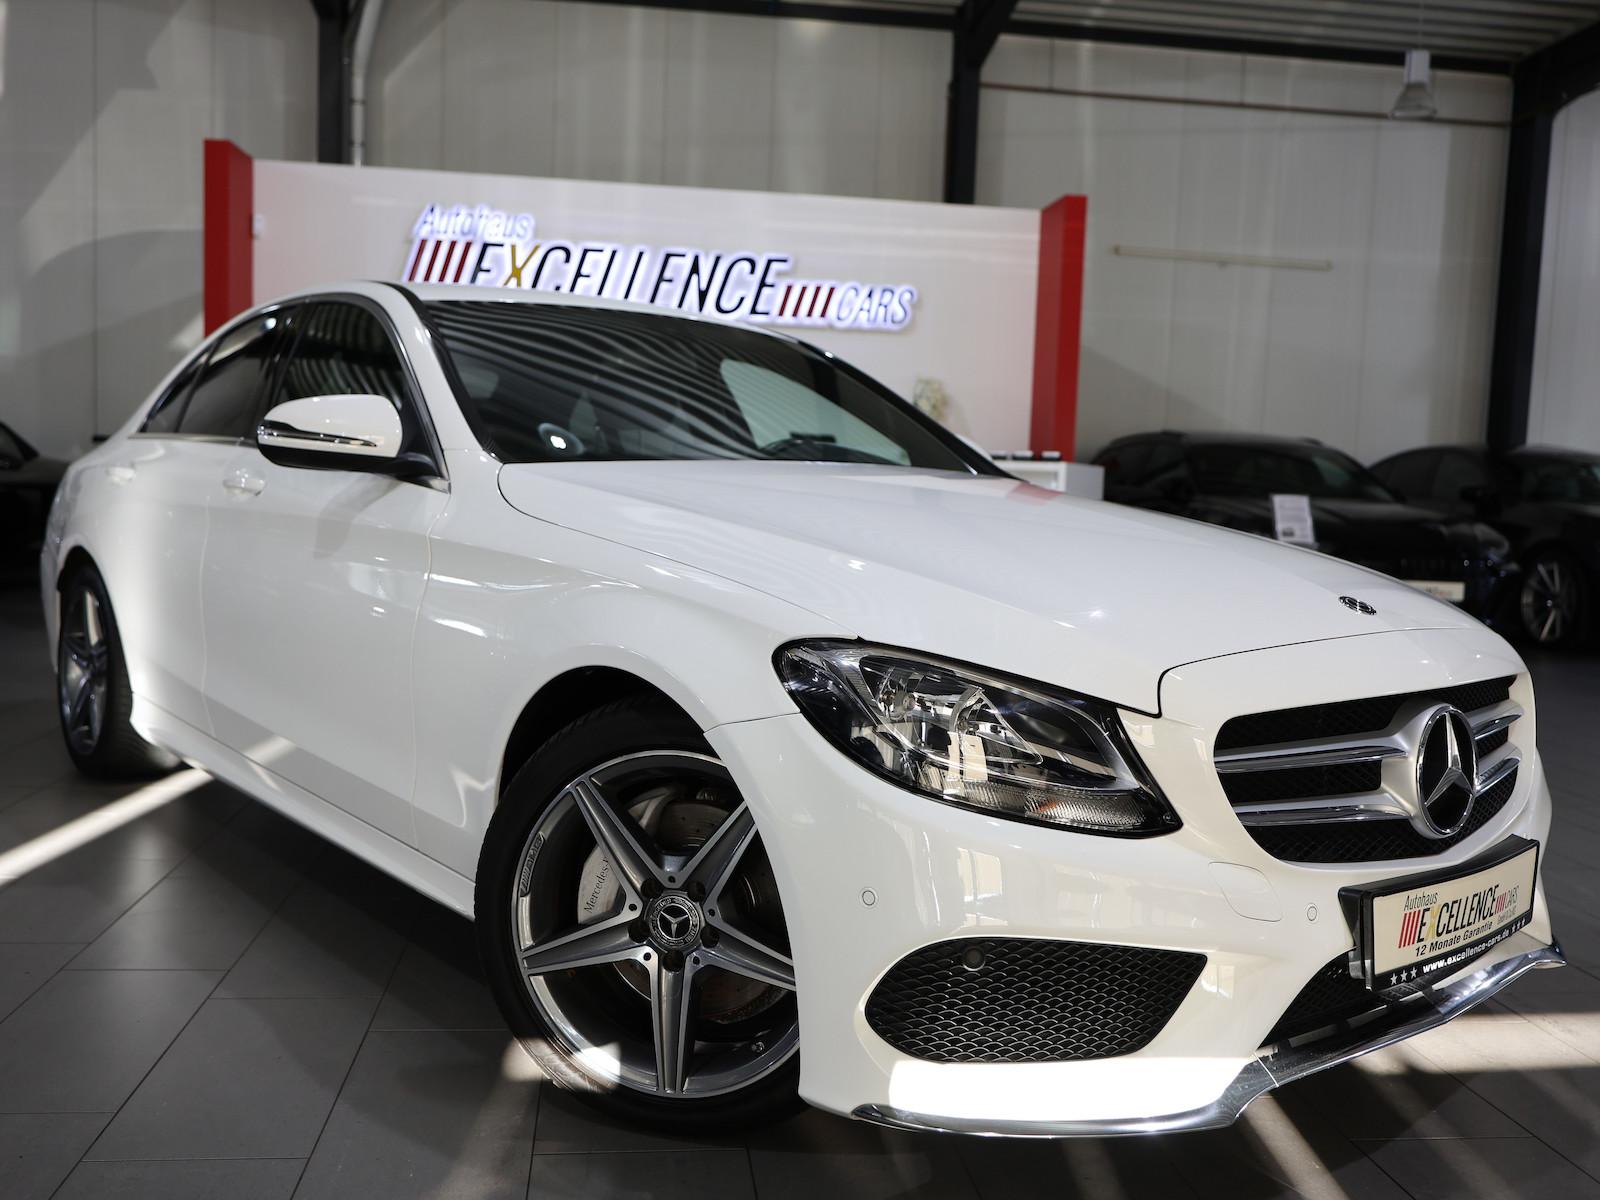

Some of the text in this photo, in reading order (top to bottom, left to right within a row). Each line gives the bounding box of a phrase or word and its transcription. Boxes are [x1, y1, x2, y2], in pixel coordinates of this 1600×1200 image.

[415, 203, 532, 240] Autohaus
[837, 286, 915, 325] CARS
[1404, 891, 1438, 911] Autohaus
[1416, 884, 1499, 943] EXCELLENCE
[1415, 920, 1493, 957] 12 Monate Garantie
[1423, 929, 1509, 974] www.excellence-cars.de
